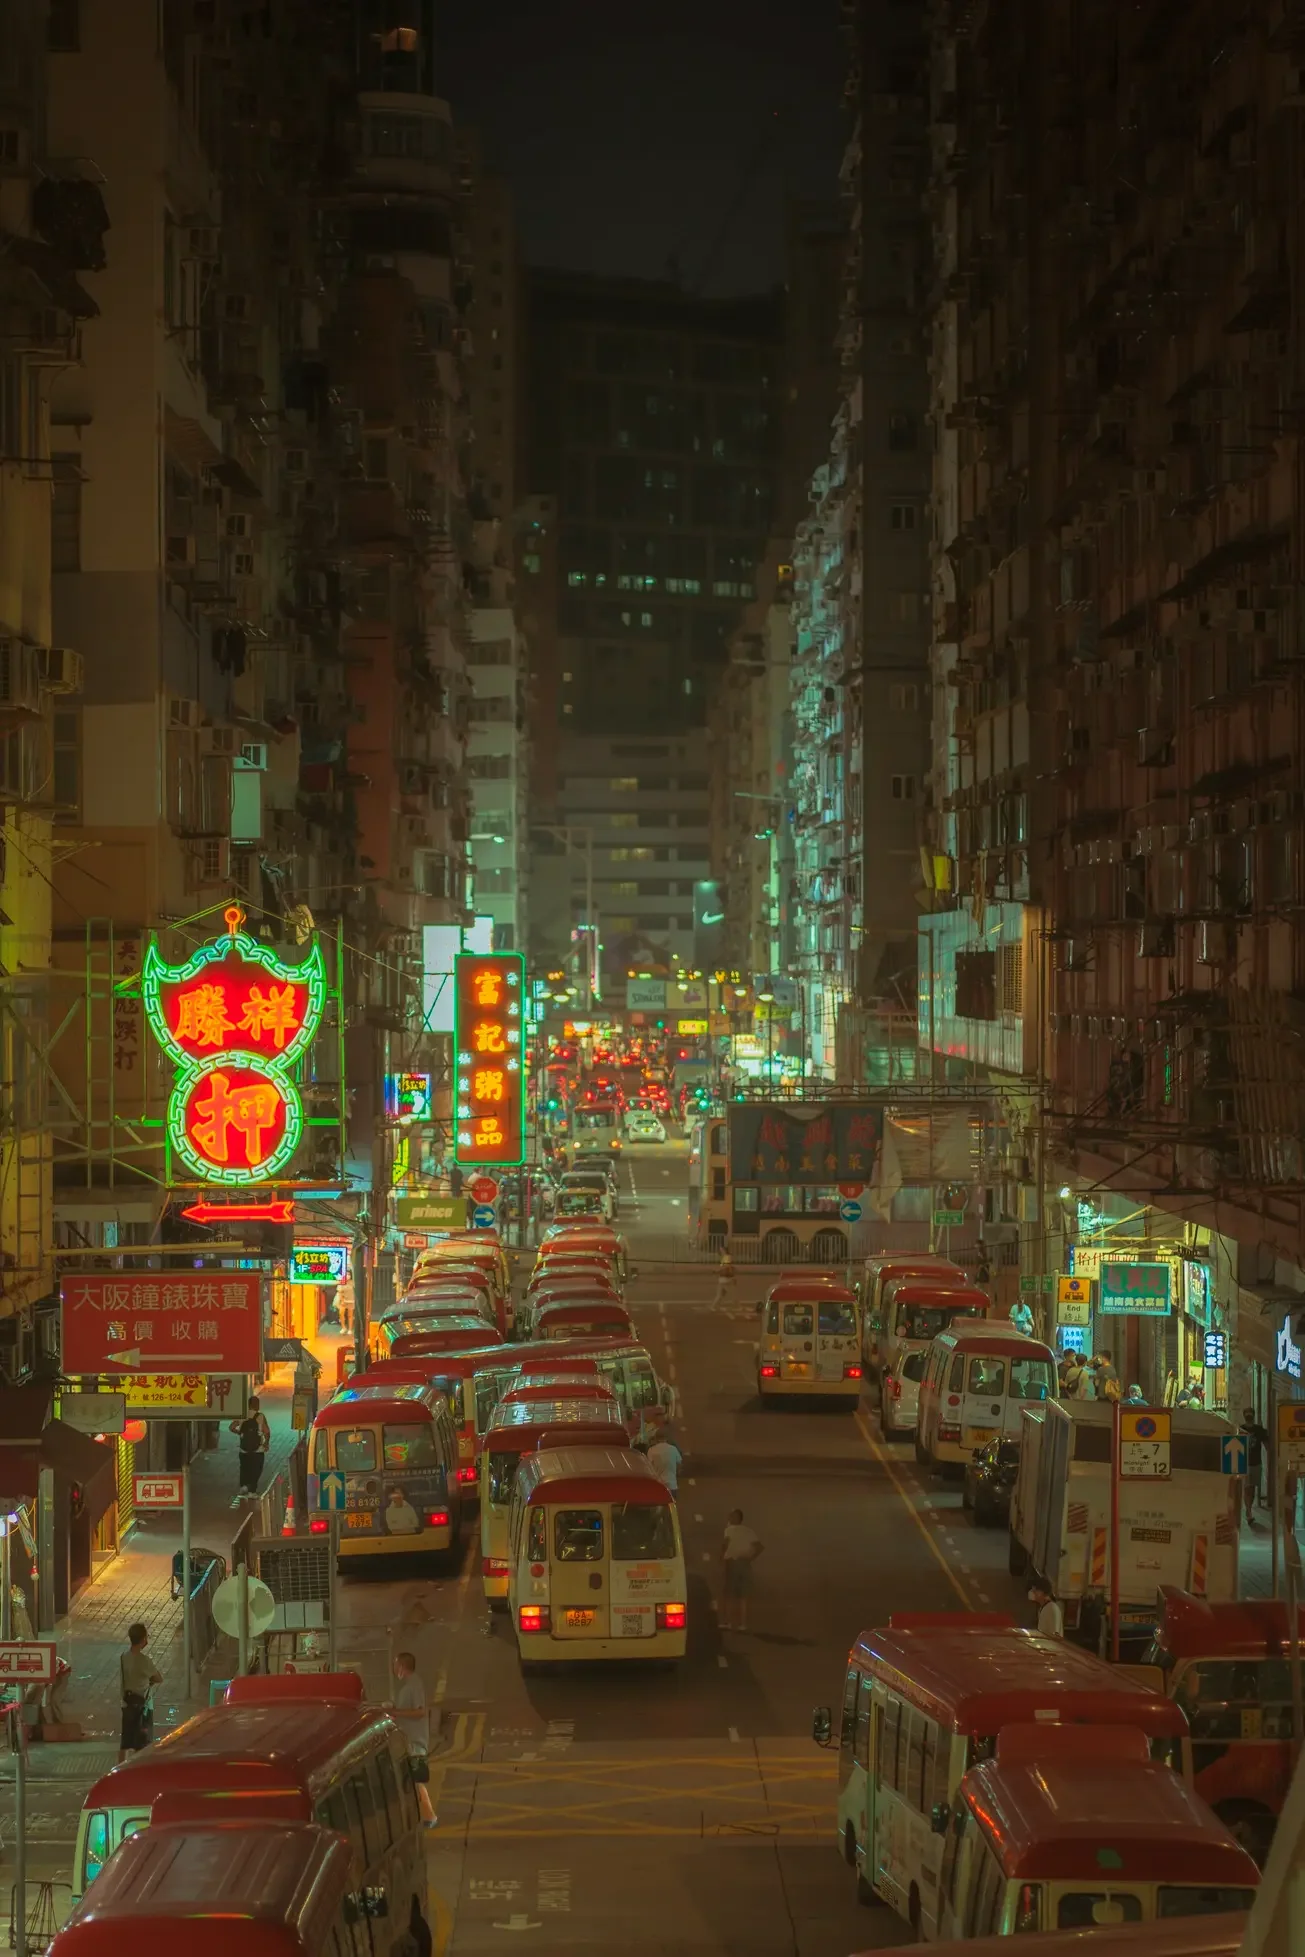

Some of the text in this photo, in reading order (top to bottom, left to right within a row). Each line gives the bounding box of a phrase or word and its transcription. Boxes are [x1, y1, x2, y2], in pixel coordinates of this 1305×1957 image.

[474, 971, 505, 1146] 富記粥品
[191, 1073, 281, 1165] 押
[72, 1283, 250, 1311] 大阪鐘錶珠寶
[1066, 1304, 1081, 1312] End
[1064, 1313, 1084, 1322] 終止
[1129, 1447, 1144, 1456] 上午
[1152, 1443, 1160, 1455] 7
[1124, 1459, 1149, 1467] midnight
[1153, 1462, 1167, 1473] 12
